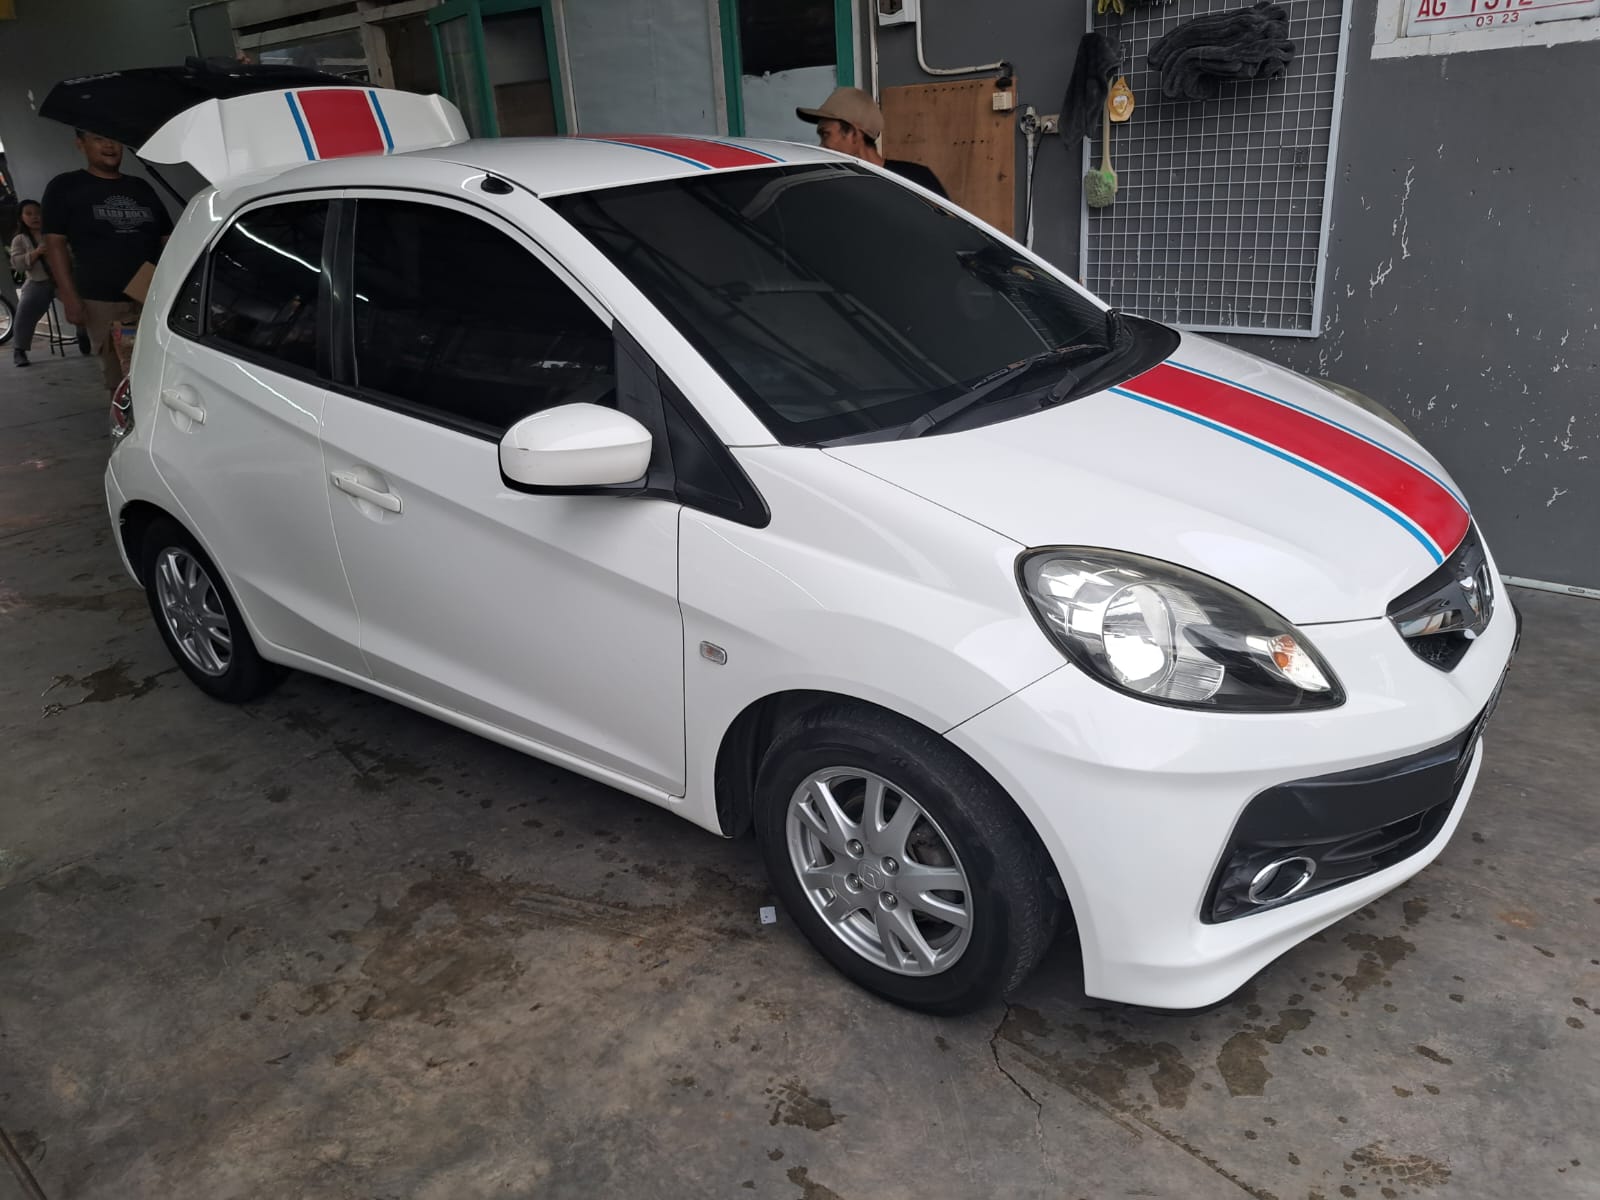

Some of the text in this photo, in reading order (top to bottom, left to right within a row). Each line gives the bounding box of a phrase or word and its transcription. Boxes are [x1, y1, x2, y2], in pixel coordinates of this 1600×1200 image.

[1417, 0, 1447, 17] AG
[1476, 12, 1520, 27] 03 23
